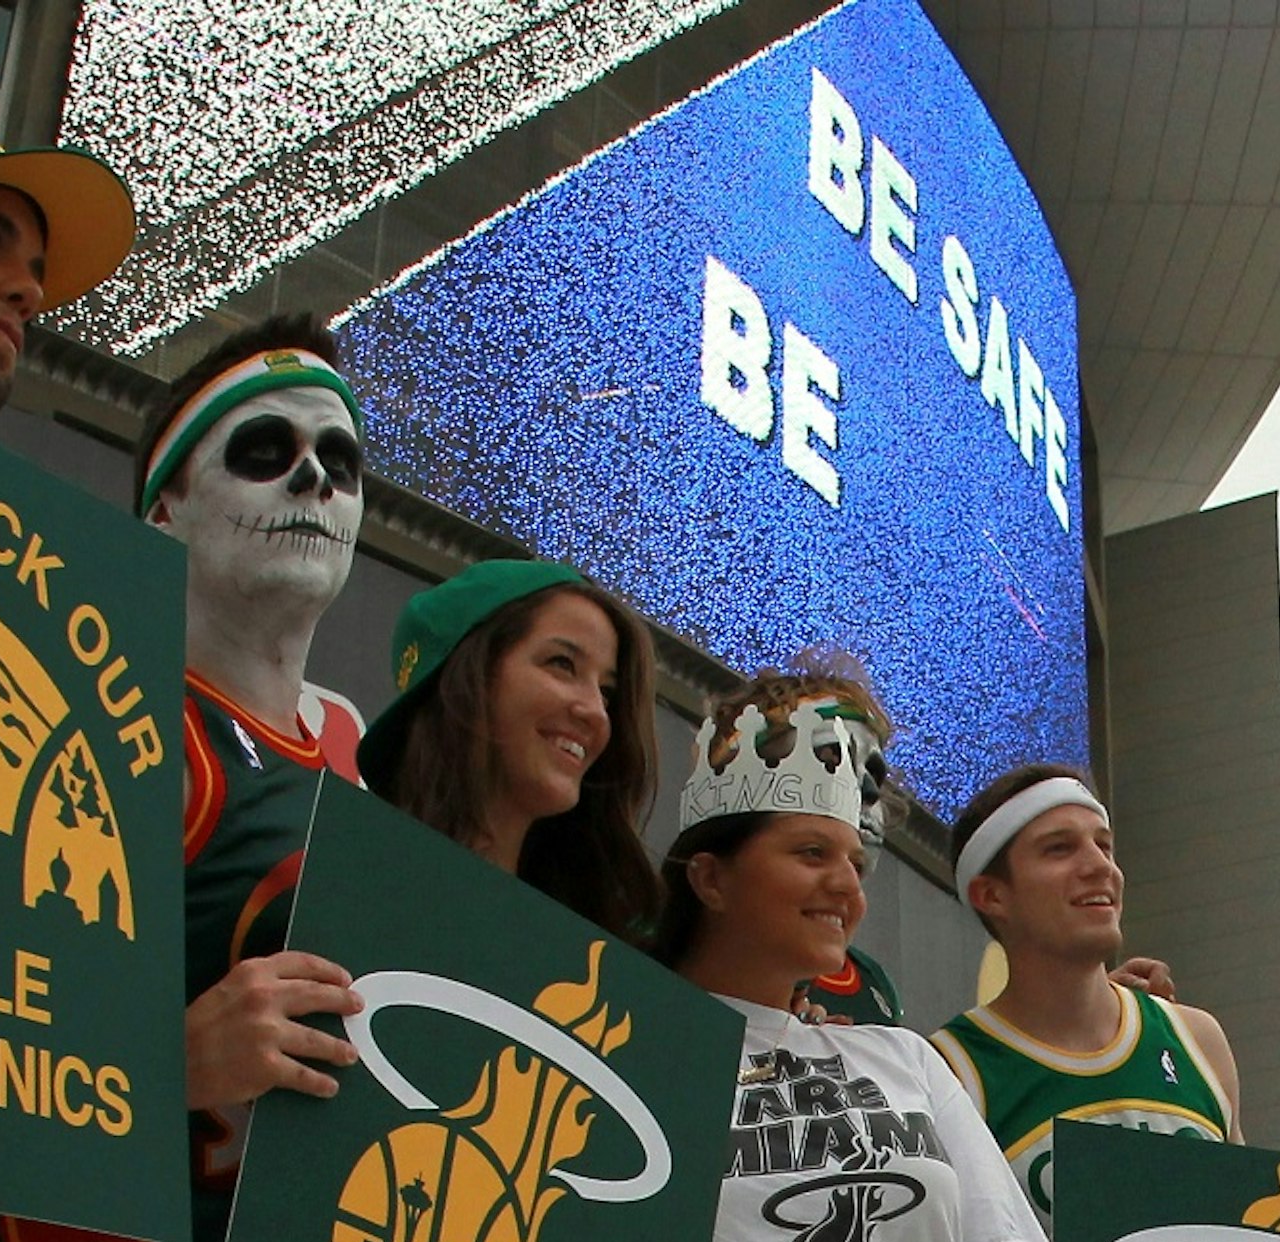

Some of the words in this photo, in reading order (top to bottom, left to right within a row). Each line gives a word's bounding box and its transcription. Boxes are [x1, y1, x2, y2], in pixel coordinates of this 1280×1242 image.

[808, 66, 918, 305] BE
[941, 235, 1070, 533] SAFE
[700, 255, 841, 508] BE
[67, 603, 164, 779] OUR
[683, 770, 804, 824] KING
[721, 1110, 952, 1178] IAM
[737, 1076, 889, 1126] ARE
